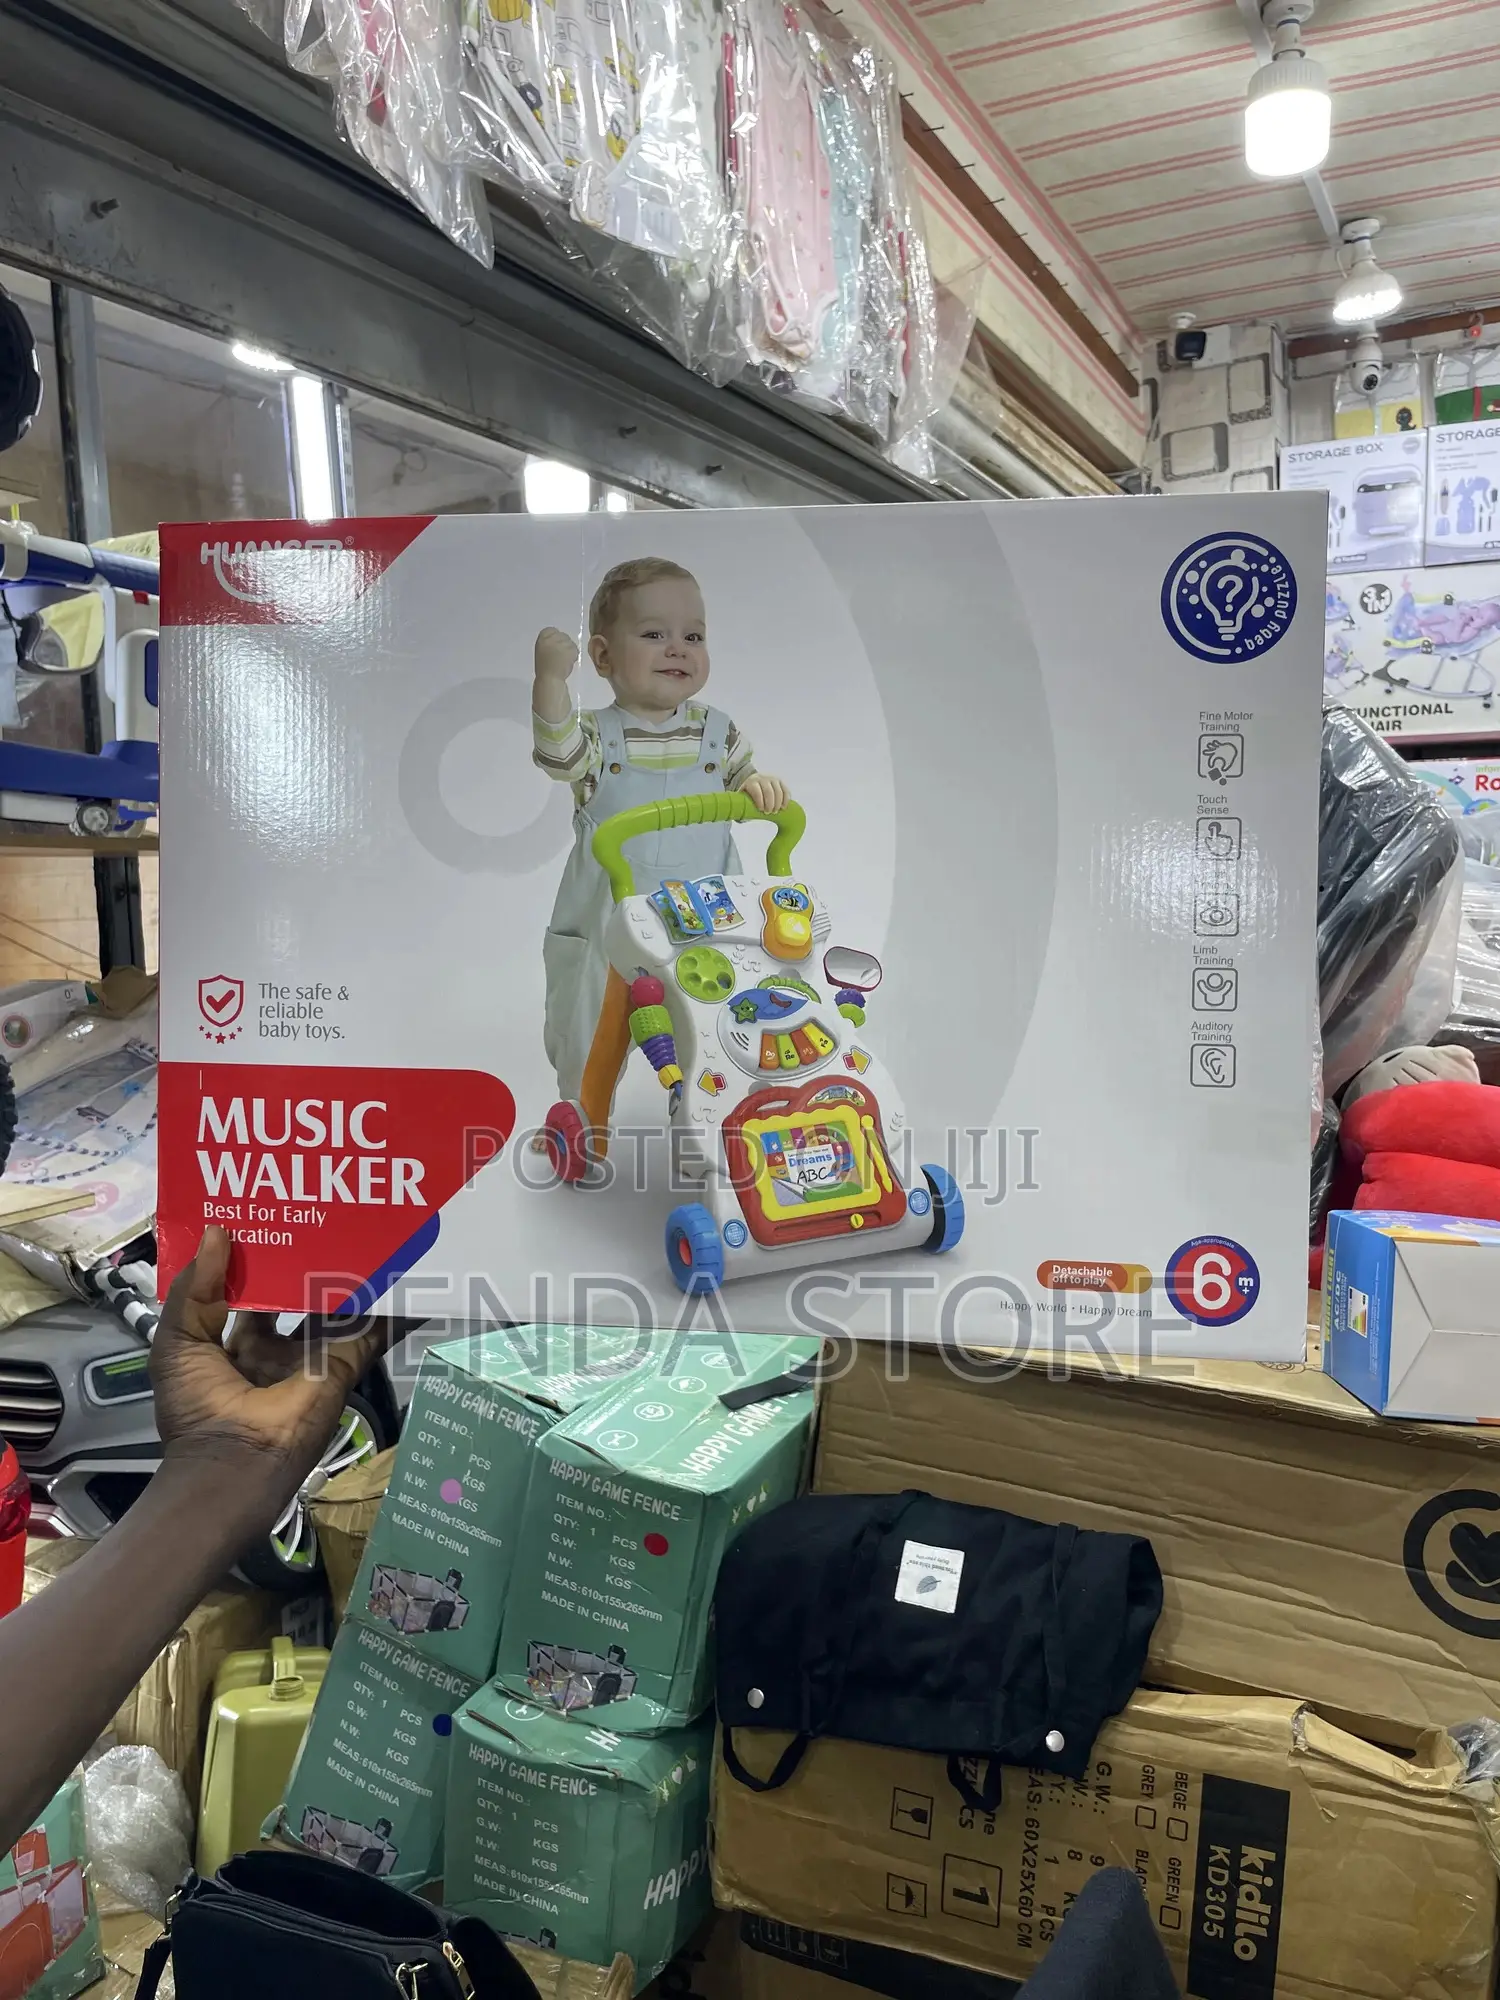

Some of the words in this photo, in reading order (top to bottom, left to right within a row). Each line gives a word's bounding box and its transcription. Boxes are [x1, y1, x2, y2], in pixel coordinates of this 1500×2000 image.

[1288, 446, 1351, 464] STORAGE
[1355, 441, 1384, 455] BOX
[1436, 428, 1500, 443] STORAGE
[1246, 621, 1281, 651] baby
[1270, 564, 1290, 619] puzzle
[1363, 586, 1377, 604] 3
[1199, 711, 1222, 721] Fine
[1224, 711, 1253, 721] Motor
[1199, 722, 1240, 732] Training
[1197, 794, 1228, 804] Touch
[1197, 805, 1229, 815] Sense
[1193, 945, 1218, 955] Limb
[1193, 956, 1234, 967] Training
[258, 982, 291, 1000] The
[295, 982, 332, 1001] safe
[337, 985, 350, 1001] &
[259, 1001, 324, 1020] reliable
[1191, 1021, 1233, 1033] Auditory
[259, 1020, 301, 1041] baby
[305, 1022, 346, 1042] toys.
[1191, 1031, 1232, 1043] Training
[197, 1095, 387, 1150] MUSIC
[195, 1149, 428, 1206] WALKER
[789, 1152, 833, 1167] Dreams
[797, 1167, 830, 1184] ABC
[203, 1201, 242, 1220] Best
[249, 1203, 277, 1222] For
[283, 1205, 327, 1227] Early
[204, 1224, 293, 1246] ucation
[1052, 1264, 1113, 1278] Detachable
[1052, 1273, 1069, 1284] off
[1070, 1274, 1081, 1285] to
[1083, 1274, 1106, 1288] play
[1192, 1252, 1232, 1310] 6
[999, 1300, 1034, 1312] Happy
[1037, 1301, 1068, 1313] World
[1079, 1304, 1115, 1316] Happy
[1116, 1306, 1153, 1318] Dream
[1333, 1270, 1342, 1330] AC/DC
[422, 1375, 465, 1404] HAPPY
[461, 1391, 499, 1420] GAME
[496, 1407, 541, 1440] FENCE
[424, 1409, 450, 1430] ITEM
[451, 1422, 475, 1440] NO.:
[417, 1431, 442, 1449] QTY:
[468, 1453, 492, 1471] PCS
[678, 1432, 743, 1479] HAPPY
[729, 1396, 784, 1438] GAME
[404, 1471, 428, 1491] N.W:
[411, 1451, 436, 1471] G.W:
[462, 1474, 487, 1492] KGS
[549, 1457, 591, 1487] HAPPY
[591, 1478, 632, 1505] GAME
[632, 1491, 682, 1522] FENCE
[556, 1492, 584, 1513] ITEM
[586, 1505, 612, 1522] NO.:
[391, 1512, 424, 1535] MADE
[423, 1527, 436, 1541] IN
[436, 1533, 471, 1557] CHINA
[553, 1513, 580, 1531] QTY:
[590, 1527, 597, 1537] 1
[611, 1534, 638, 1551] PCS
[551, 1532, 578, 1550] G.W:
[609, 1554, 636, 1571] KGS
[547, 1551, 574, 1569] N.W:
[605, 1573, 632, 1590] KGS
[541, 1590, 576, 1612] MADE
[577, 1604, 590, 1618] IN
[592, 1611, 630, 1633] CHINA
[357, 1628, 393, 1660] HAPPY
[391, 1649, 429, 1680] GAME
[427, 1667, 471, 1698] FENCE
[359, 1661, 383, 1681] ITEM
[383, 1677, 406, 1695] NO.:
[352, 1680, 376, 1701] QTY:
[382, 1700, 388, 1709] 1
[400, 1708, 424, 1727] PCS
[346, 1700, 369, 1721] G.W:
[393, 1728, 417, 1747] KGS
[340, 1719, 361, 1739] N.W:
[385, 1747, 410, 1766] KGS
[326, 1757, 354, 1782] MADE
[354, 1775, 367, 1790] IN
[367, 1783, 401, 1807] CHINA
[468, 1742, 507, 1773] HAPPY
[508, 1761, 547, 1789] GAME
[550, 1775, 598, 1797] FENCE
[1140, 1764, 1156, 1800] GREY
[477, 1776, 505, 1795] ITEM
[506, 1789, 531, 1807] NO.:
[1026, 1765, 1044, 1812] EAS:
[1093, 1761, 1113, 1815] G.W.:
[1172, 1771, 1189, 1811] BEIGE
[476, 1797, 503, 1815] QTY:
[511, 1812, 517, 1821] 1
[533, 1818, 559, 1834] PCS
[958, 1804, 975, 1831] CS
[476, 1816, 502, 1834] G.W:
[533, 1838, 559, 1853] KGS
[475, 1835, 500, 1852] N.W:
[531, 1857, 558, 1872] KGS
[1017, 1817, 1041, 1919] 60X25X60
[1044, 1855, 1060, 1866] 1
[1067, 1849, 1083, 1862] 8
[1089, 1854, 1106, 1868] 9
[473, 1873, 507, 1895] MADE
[509, 1888, 522, 1901] IN
[522, 1893, 560, 1916] CHINA
[952, 1886, 990, 1907] 1
[1165, 1857, 1182, 1903] GREEN
[1202, 1844, 1231, 1939] KD305
[1233, 1845, 1277, 1961] kidilo
[1016, 1922, 1033, 1950] CM
[1039, 1903, 1057, 1944] PCS
